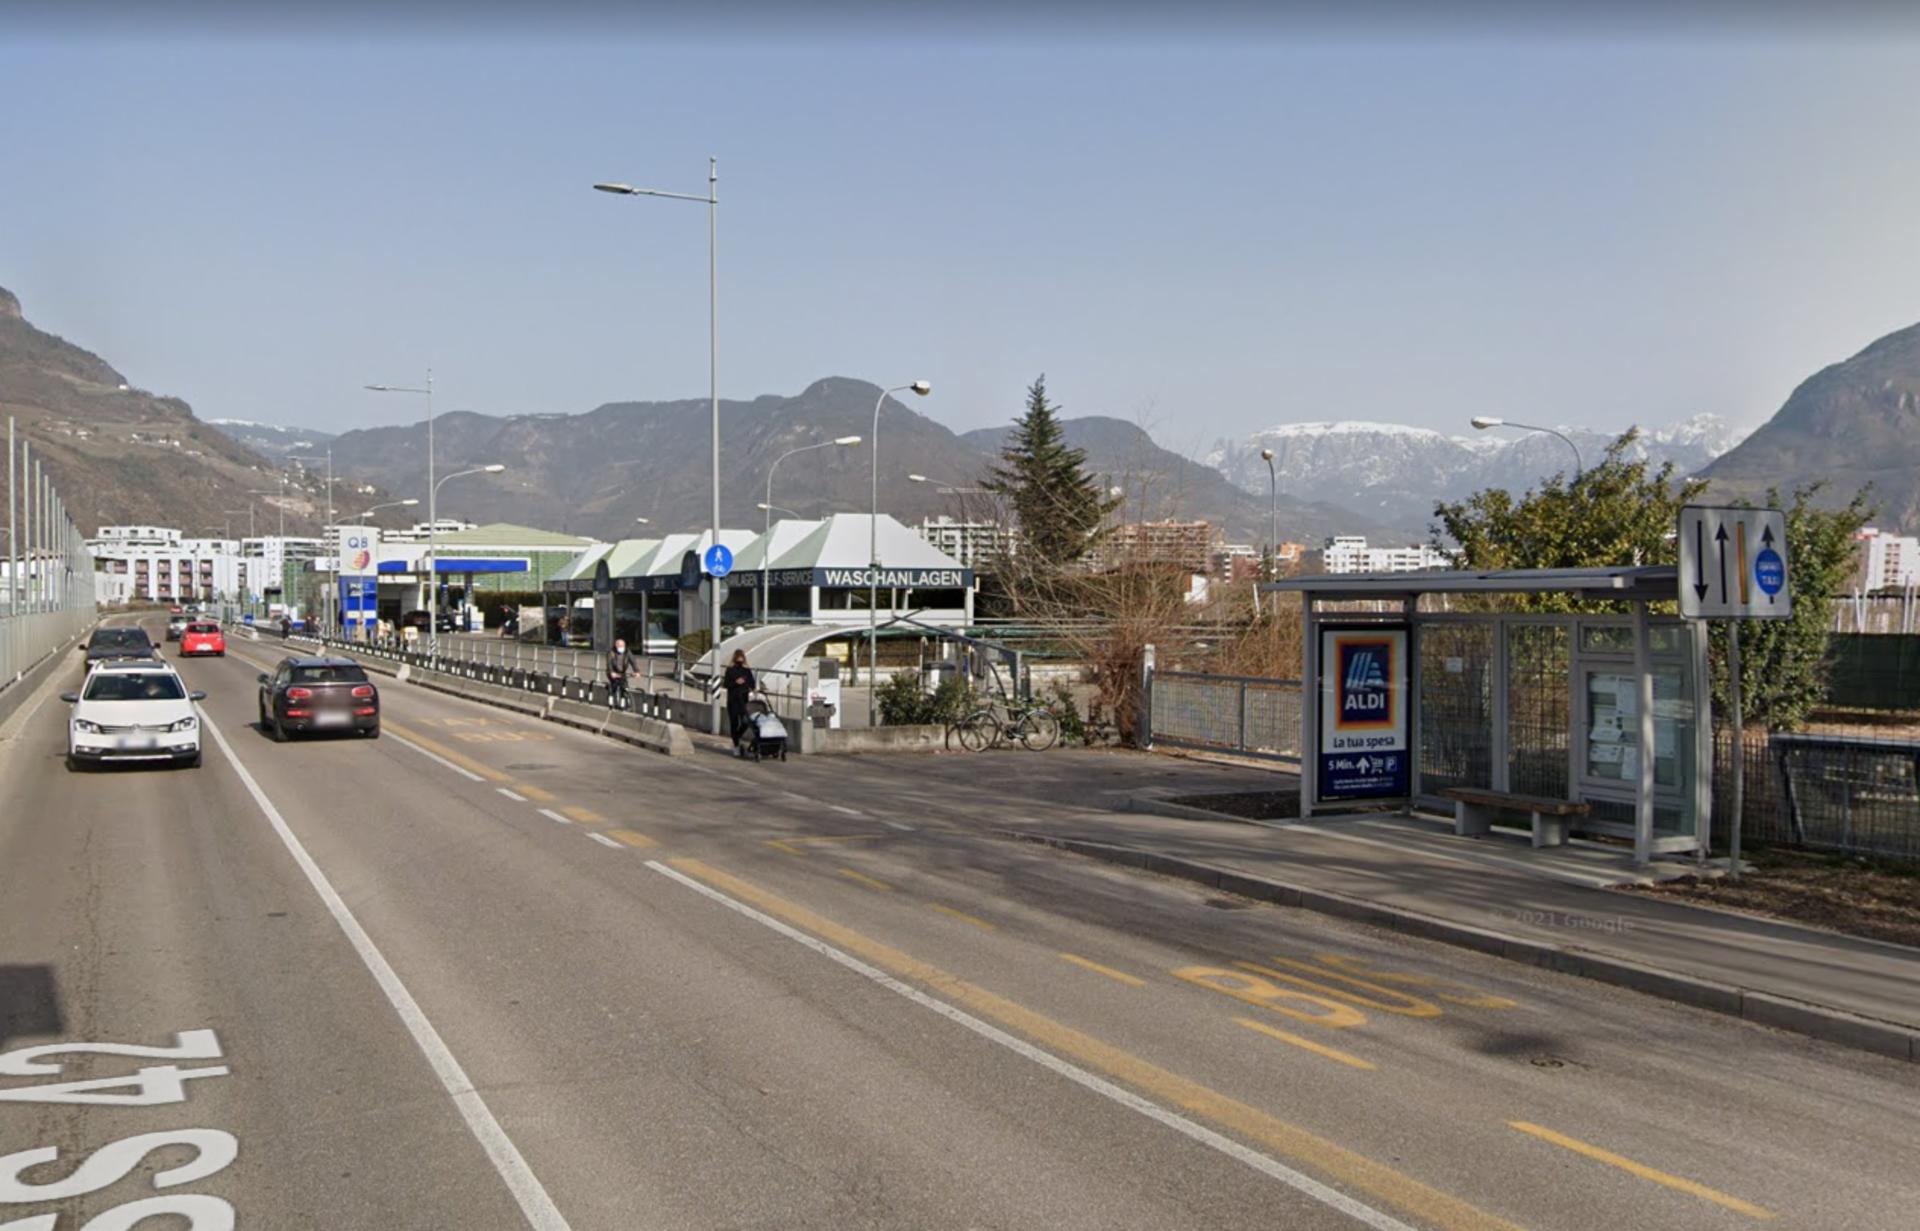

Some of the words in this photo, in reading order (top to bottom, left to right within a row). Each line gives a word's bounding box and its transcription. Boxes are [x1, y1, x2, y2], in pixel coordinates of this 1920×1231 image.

[348, 537, 368, 549] Q8
[825, 570, 963, 586] WASCHANLAGEN
[1345, 693, 1385, 710] ALDI
[1334, 737, 1345, 748] La
[1347, 737, 1365, 748] tua
[1367, 736, 1395, 749] spesa
[1328, 760, 1334, 771] 5
[1169, 953, 1518, 1029] BUS
